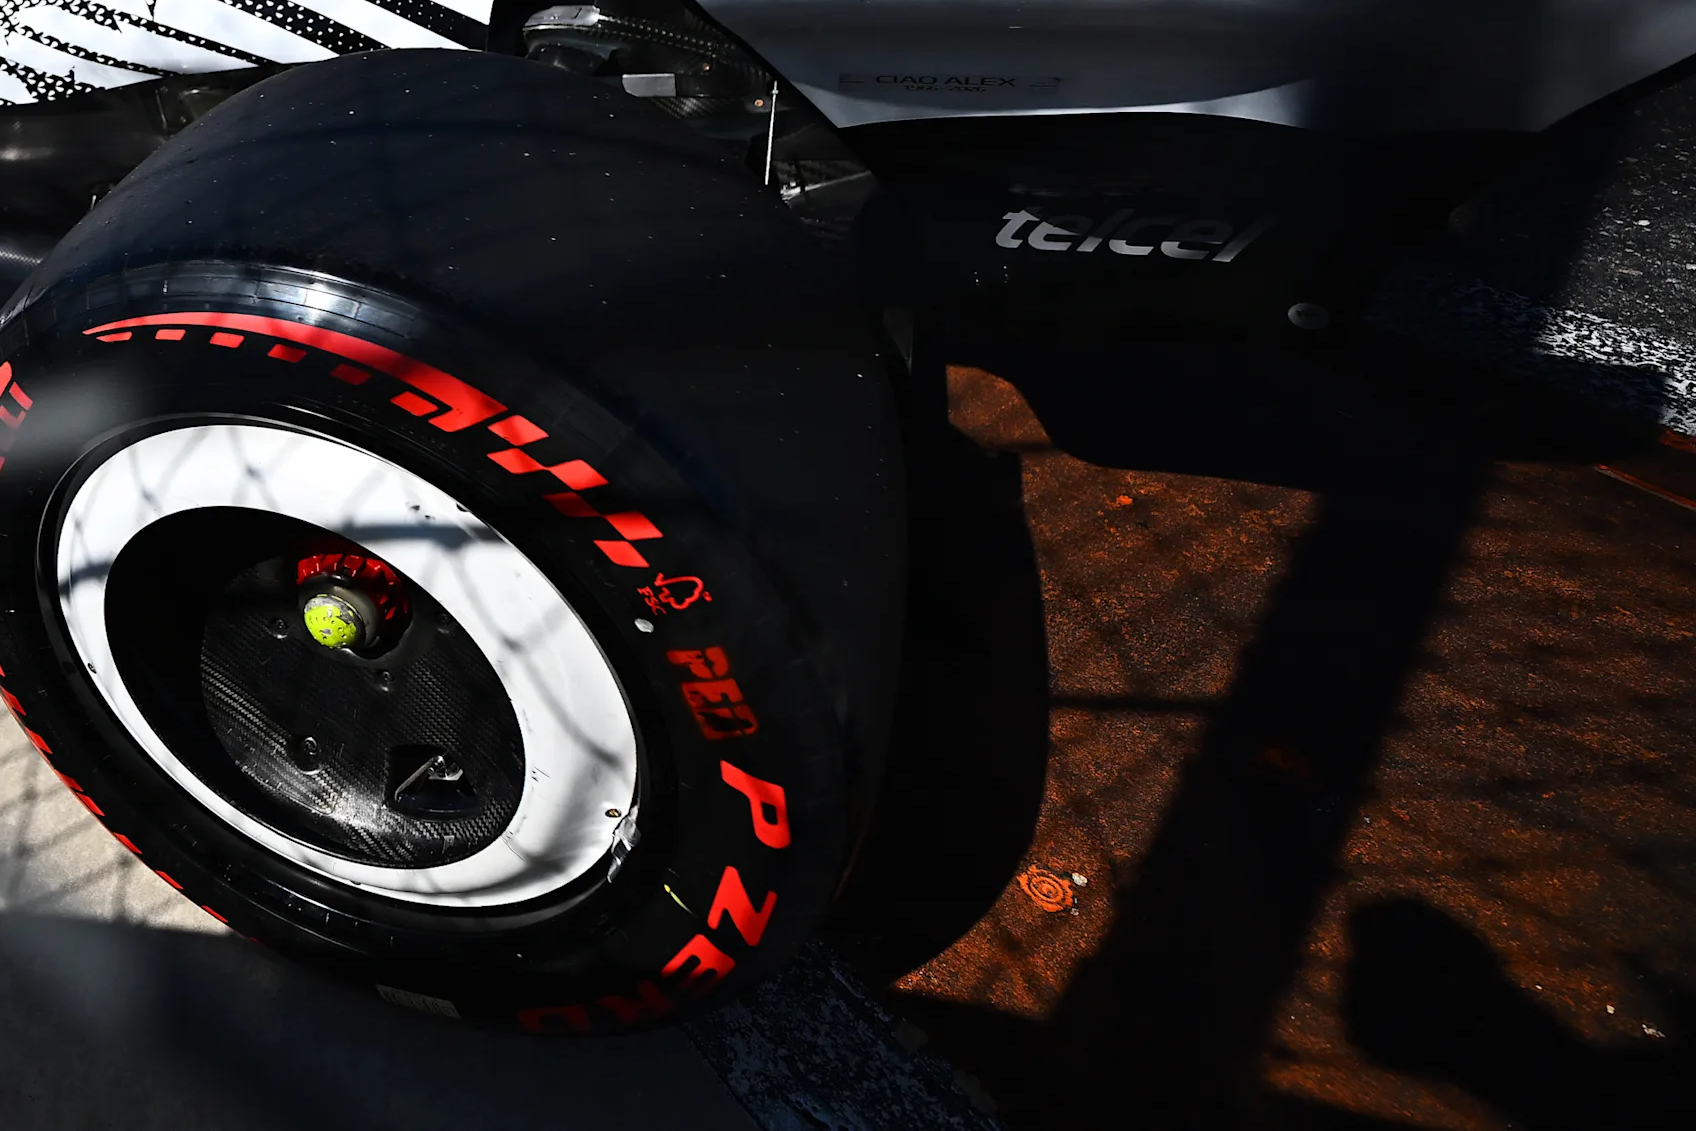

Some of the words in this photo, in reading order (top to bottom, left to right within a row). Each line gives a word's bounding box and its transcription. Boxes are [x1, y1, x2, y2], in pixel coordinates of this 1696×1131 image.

[875, 75, 938, 85] CIAO
[944, 76, 1016, 87] ALEX
[995, 206, 1280, 262] telcel
[719, 759, 792, 849] P
